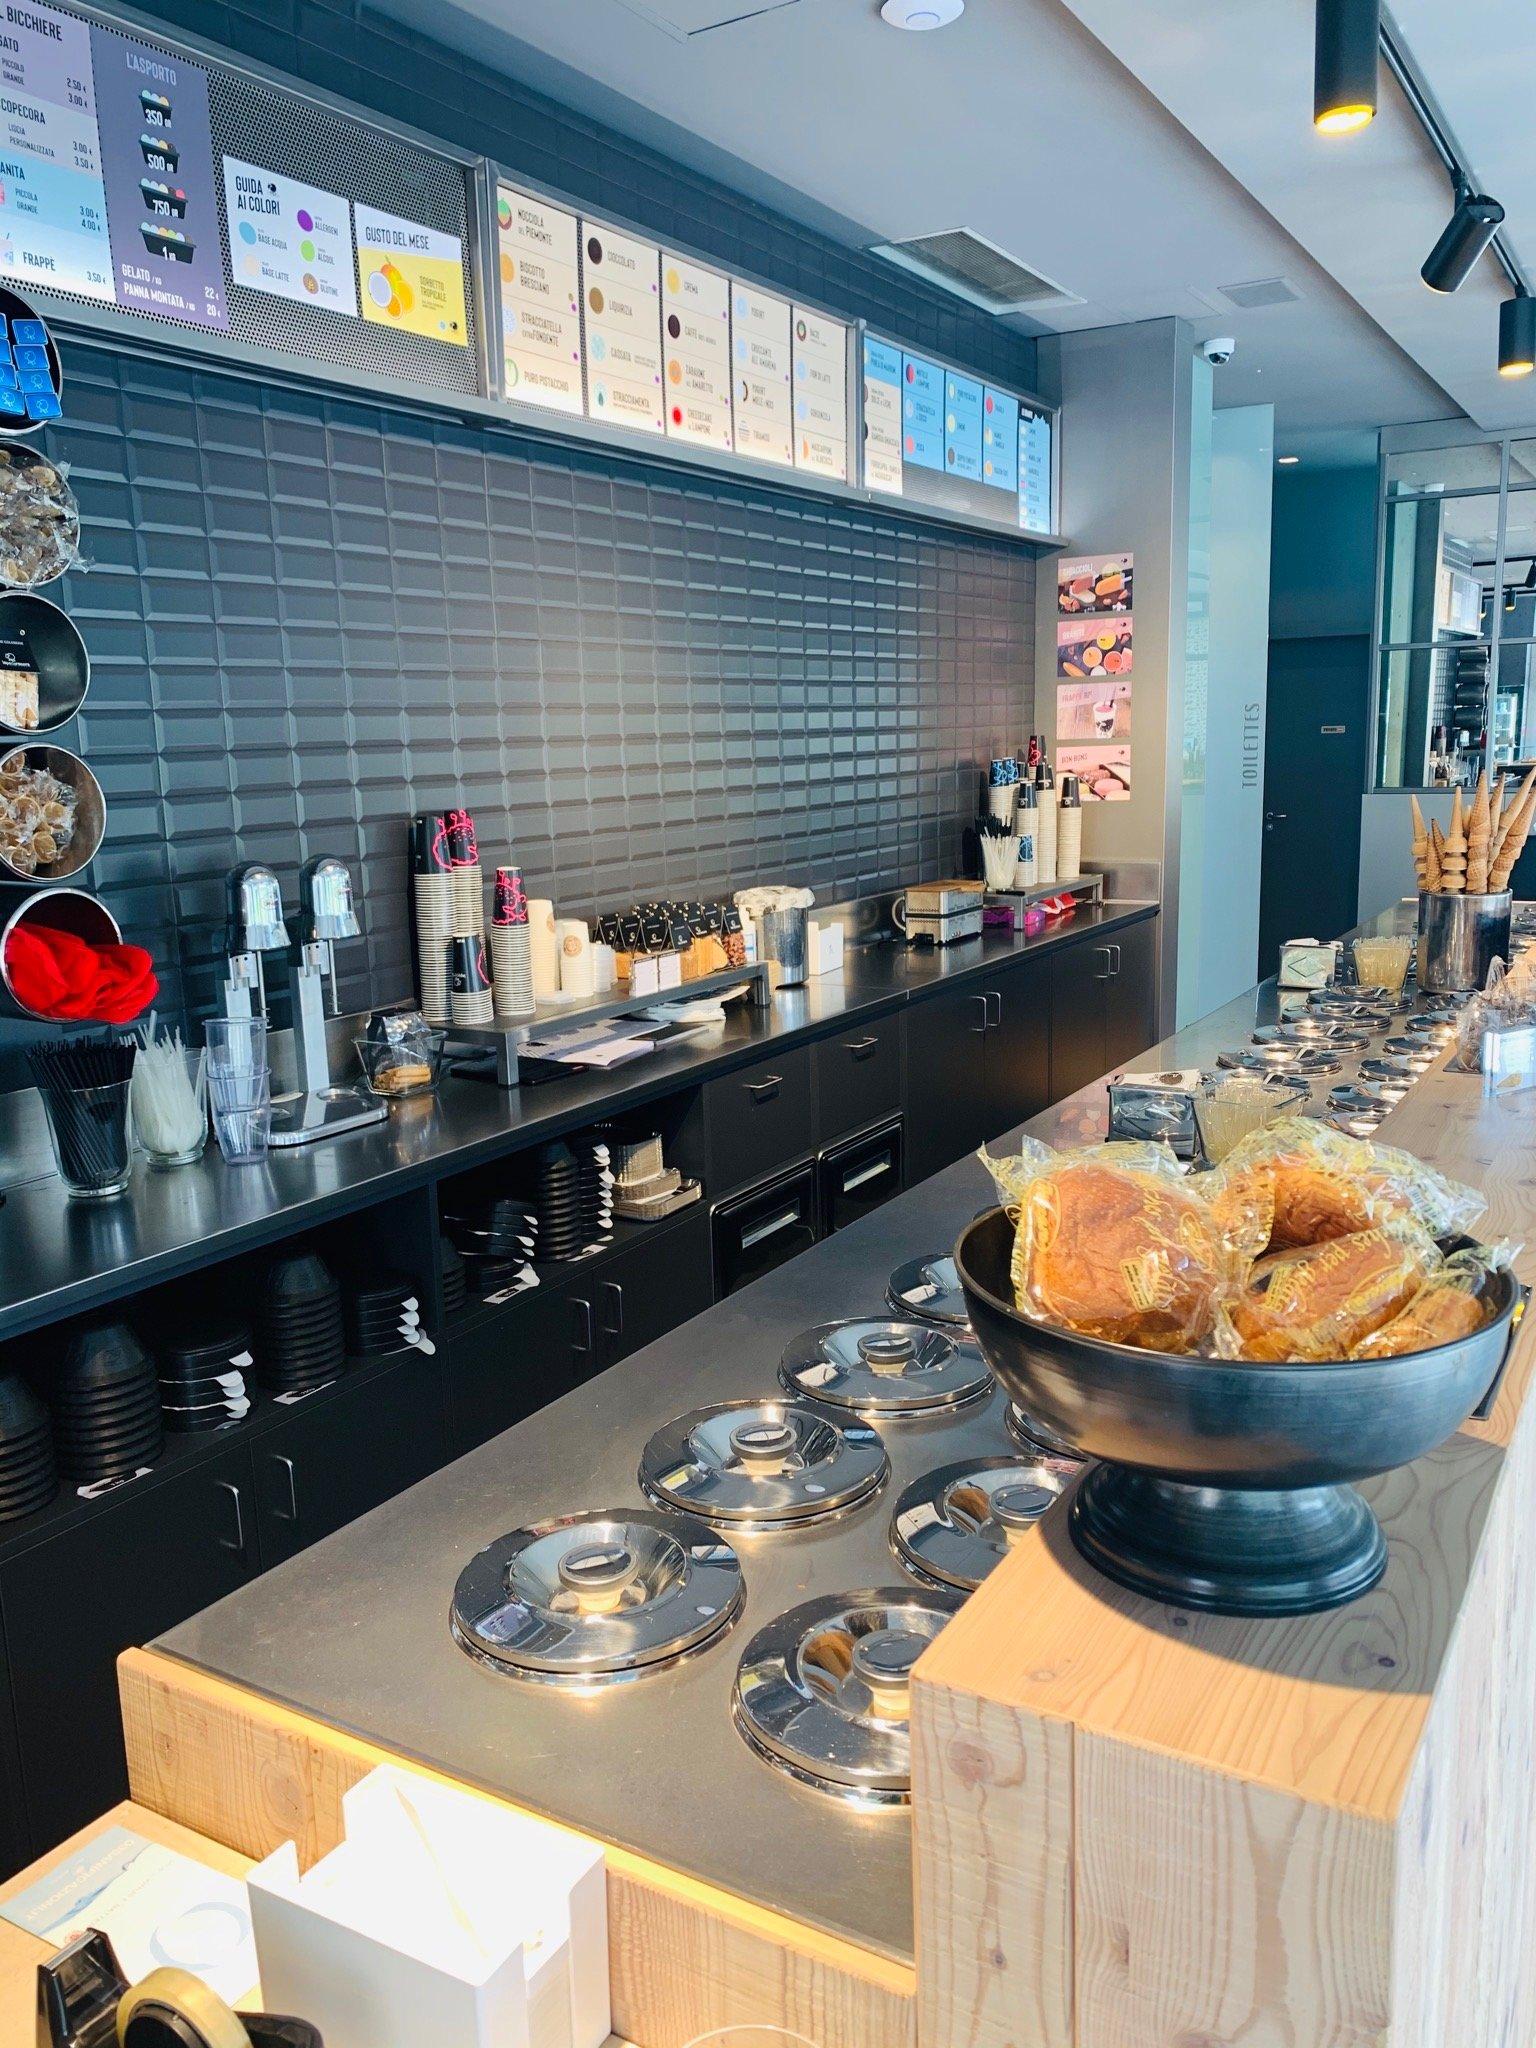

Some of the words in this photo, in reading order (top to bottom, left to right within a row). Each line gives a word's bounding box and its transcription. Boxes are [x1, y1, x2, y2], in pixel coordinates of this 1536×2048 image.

[7, 6, 62, 41] BICCHIERE
[126, 52, 177, 86] L'ASPORTO
[68, 93, 82, 107] 3.00
[145, 108, 163, 127] 350
[9, 136, 55, 157] PERSONALIZZATA
[73, 141, 87, 154] 3.00
[74, 156, 89, 169] 3.50
[147, 153, 165, 171] 500
[235, 175, 263, 195] GUIDA
[15, 188, 38, 201] PICCOLA
[17, 201, 39, 215] GRANDE
[80, 206, 94, 218] 3.00
[153, 200, 170, 215] 750
[237, 194, 247, 210] AI
[248, 196, 280, 215] COLORI
[82, 219, 96, 231] 4.00
[518, 208, 544, 227] NOCCIOLA
[315, 221, 339, 236] ALLERGENI
[526, 226, 553, 246] PIEMONTE
[258, 233, 272, 245] BASE
[271, 238, 288, 250] ACQUA
[365, 226, 391, 244] GUSTO
[392, 231, 407, 247] DEL
[408, 233, 430, 250] MESE
[162, 246, 168, 261] 1
[122, 264, 150, 281] GELATO
[261, 266, 275, 278] BASE
[275, 271, 290, 282] LATTE
[520, 261, 545, 280] BISCOTTO
[420, 275, 445, 292] SORBETTO
[521, 275, 550, 295] BRESCIANO
[684, 282, 699, 294] CREMA
[123, 281, 150, 300] PANNA
[150, 288, 184, 309] MONTATA
[205, 286, 215, 300] 22
[420, 286, 447, 302] TROPICALE
[207, 304, 217, 317] 20
[521, 312, 562, 333] STRACCIATELLA
[539, 375, 569, 392] PISTACCHIO
[1242, 703, 1260, 789] TOILETTES
